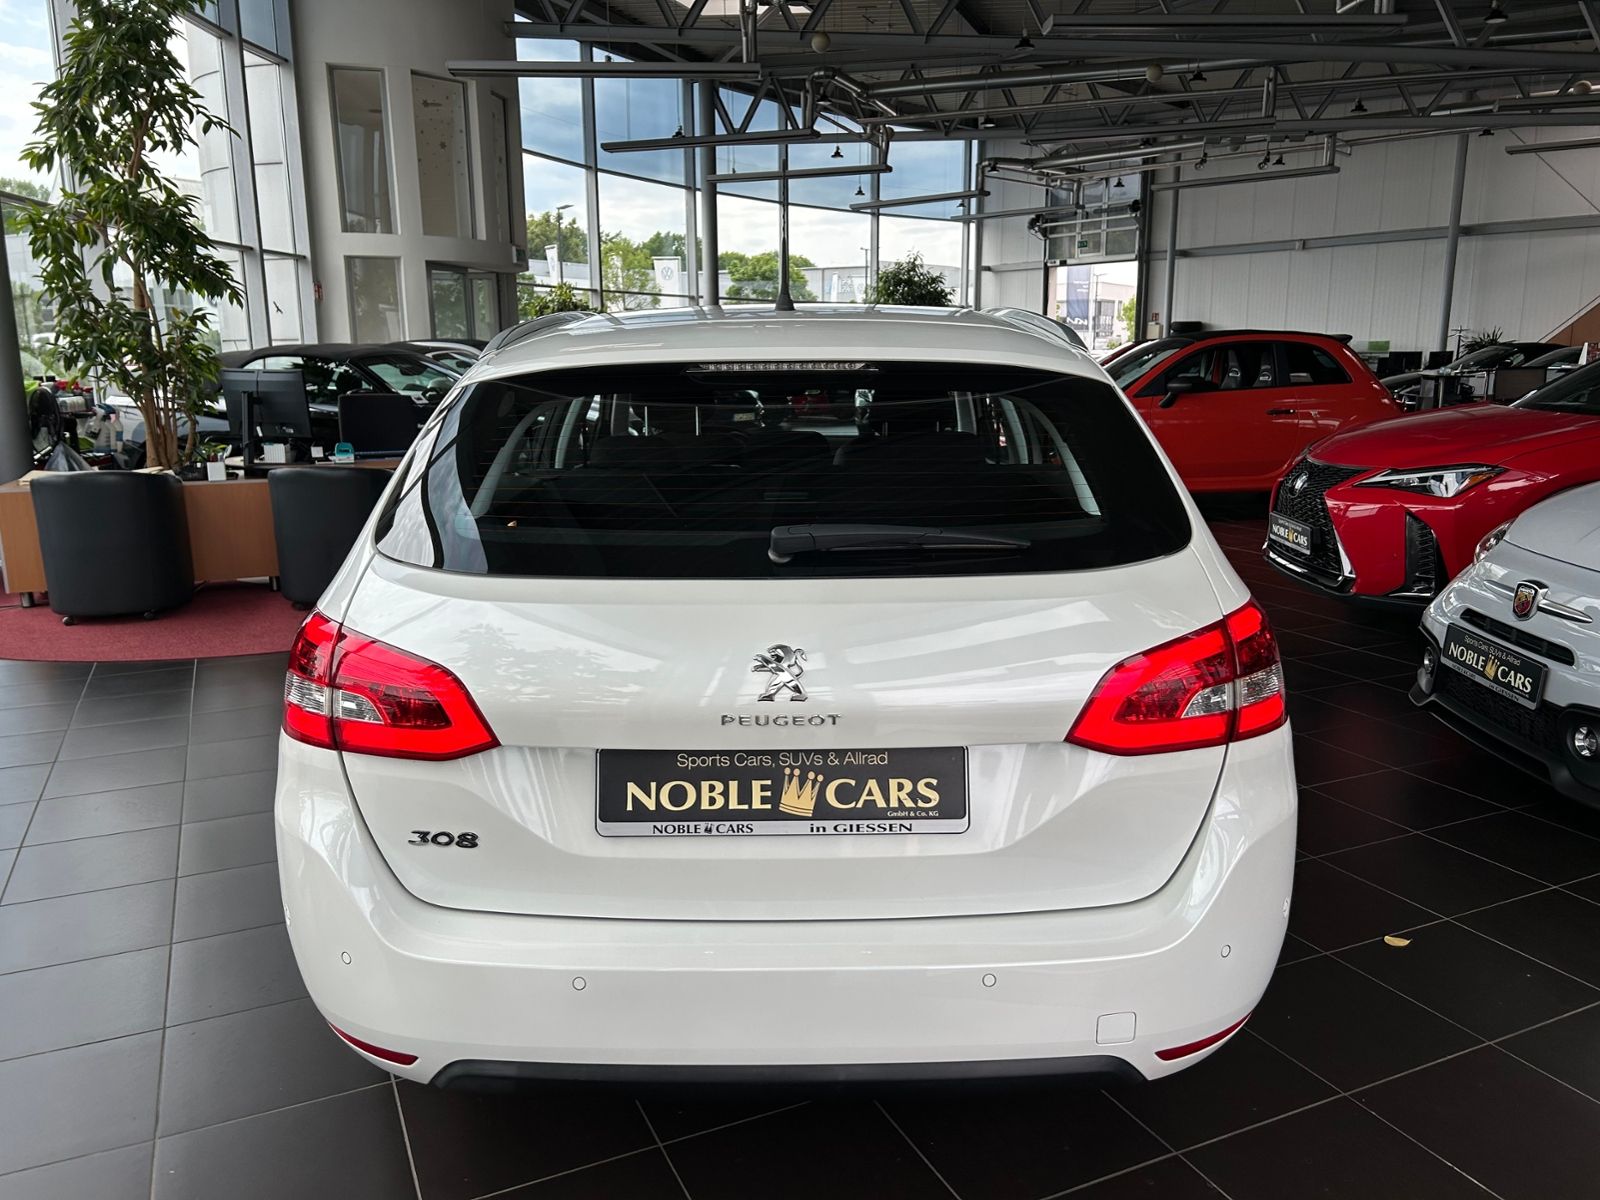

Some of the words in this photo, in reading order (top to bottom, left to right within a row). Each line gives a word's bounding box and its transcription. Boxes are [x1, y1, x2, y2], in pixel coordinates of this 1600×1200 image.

[1293, 532, 1308, 546] CARS
[1448, 641, 1485, 671] NOBLE
[1497, 665, 1532, 693] CARS
[720, 714, 843, 726] PEUGEOT
[676, 753, 730, 770] Sports
[734, 752, 776, 768] Cars,
[778, 751, 823, 766] SUVs
[827, 751, 840, 766] &
[843, 750, 888, 765] Allrad
[626, 779, 772, 812] NOBLE
[825, 777, 941, 809] CARS
[652, 824, 701, 835] NOBLE
[715, 823, 754, 834] CARS
[809, 823, 827, 833] in
[833, 822, 913, 833] GIESSEN
[408, 830, 479, 848] 308
